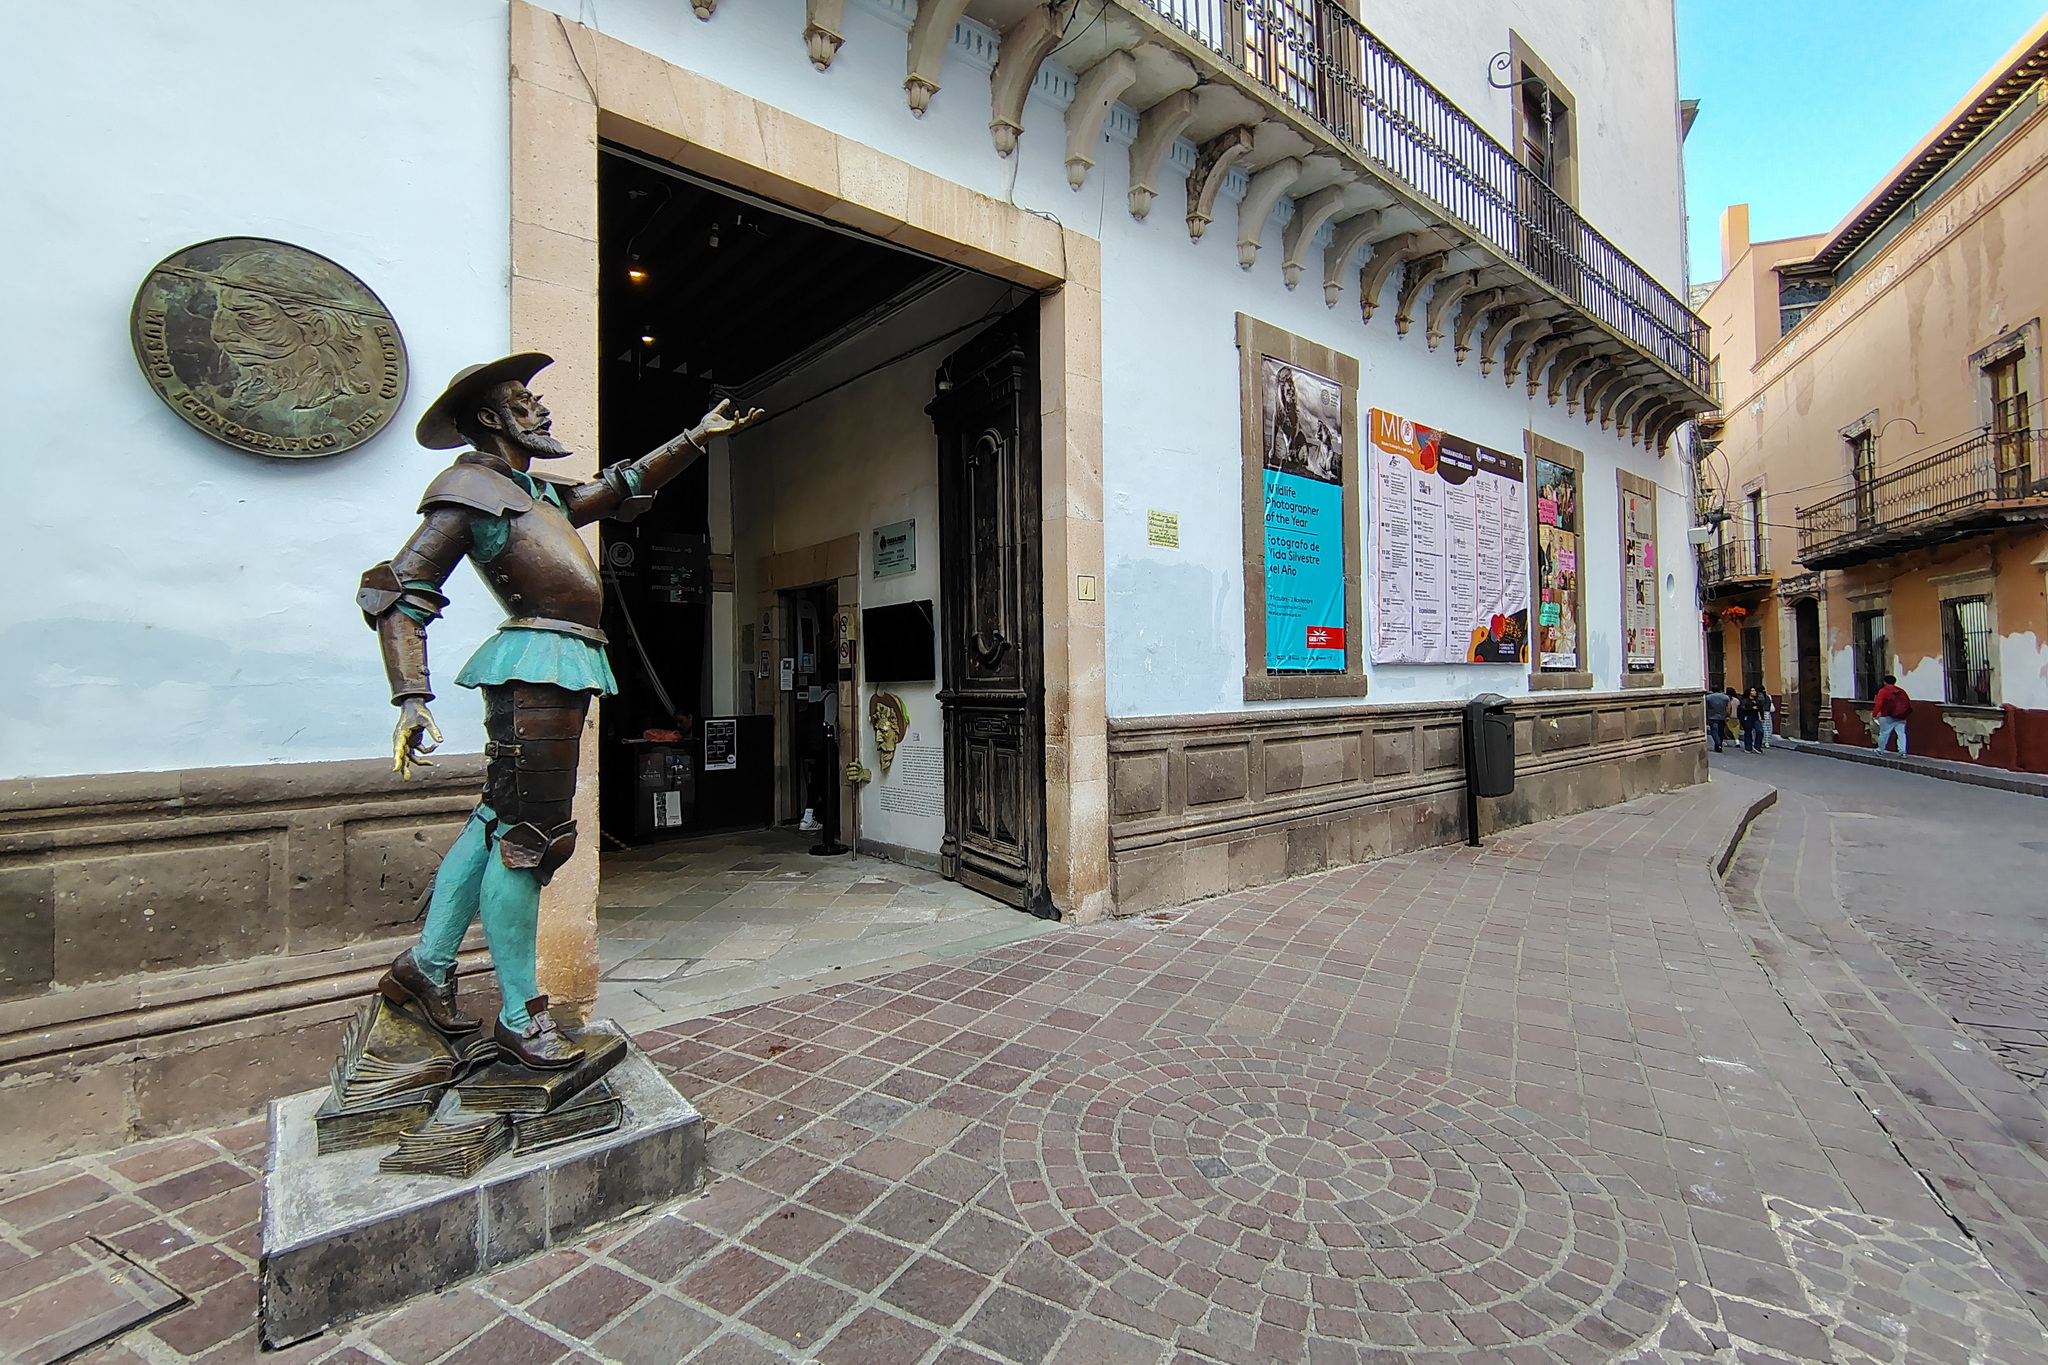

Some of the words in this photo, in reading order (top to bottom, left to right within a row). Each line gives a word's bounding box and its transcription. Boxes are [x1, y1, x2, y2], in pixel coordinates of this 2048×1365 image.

[144, 307, 175, 380] MUSEO
[173, 390, 336, 452] ICONOGRAFICO
[346, 409, 382, 437] DEL
[374, 324, 400, 400] QUIJOTE
[1381, 412, 1414, 448] MIQ
[1267, 482, 1296, 499] Wildlife
[1265, 496, 1319, 516] Photographer
[1265, 511, 1276, 522] of
[1276, 513, 1290, 525] the
[1291, 515, 1308, 528] Year
[1267, 534, 1308, 550] Fotógrafo
[1310, 543, 1320, 552] de
[1288, 550, 1320, 565] Silvestre
[1281, 564, 1297, 576] Año
